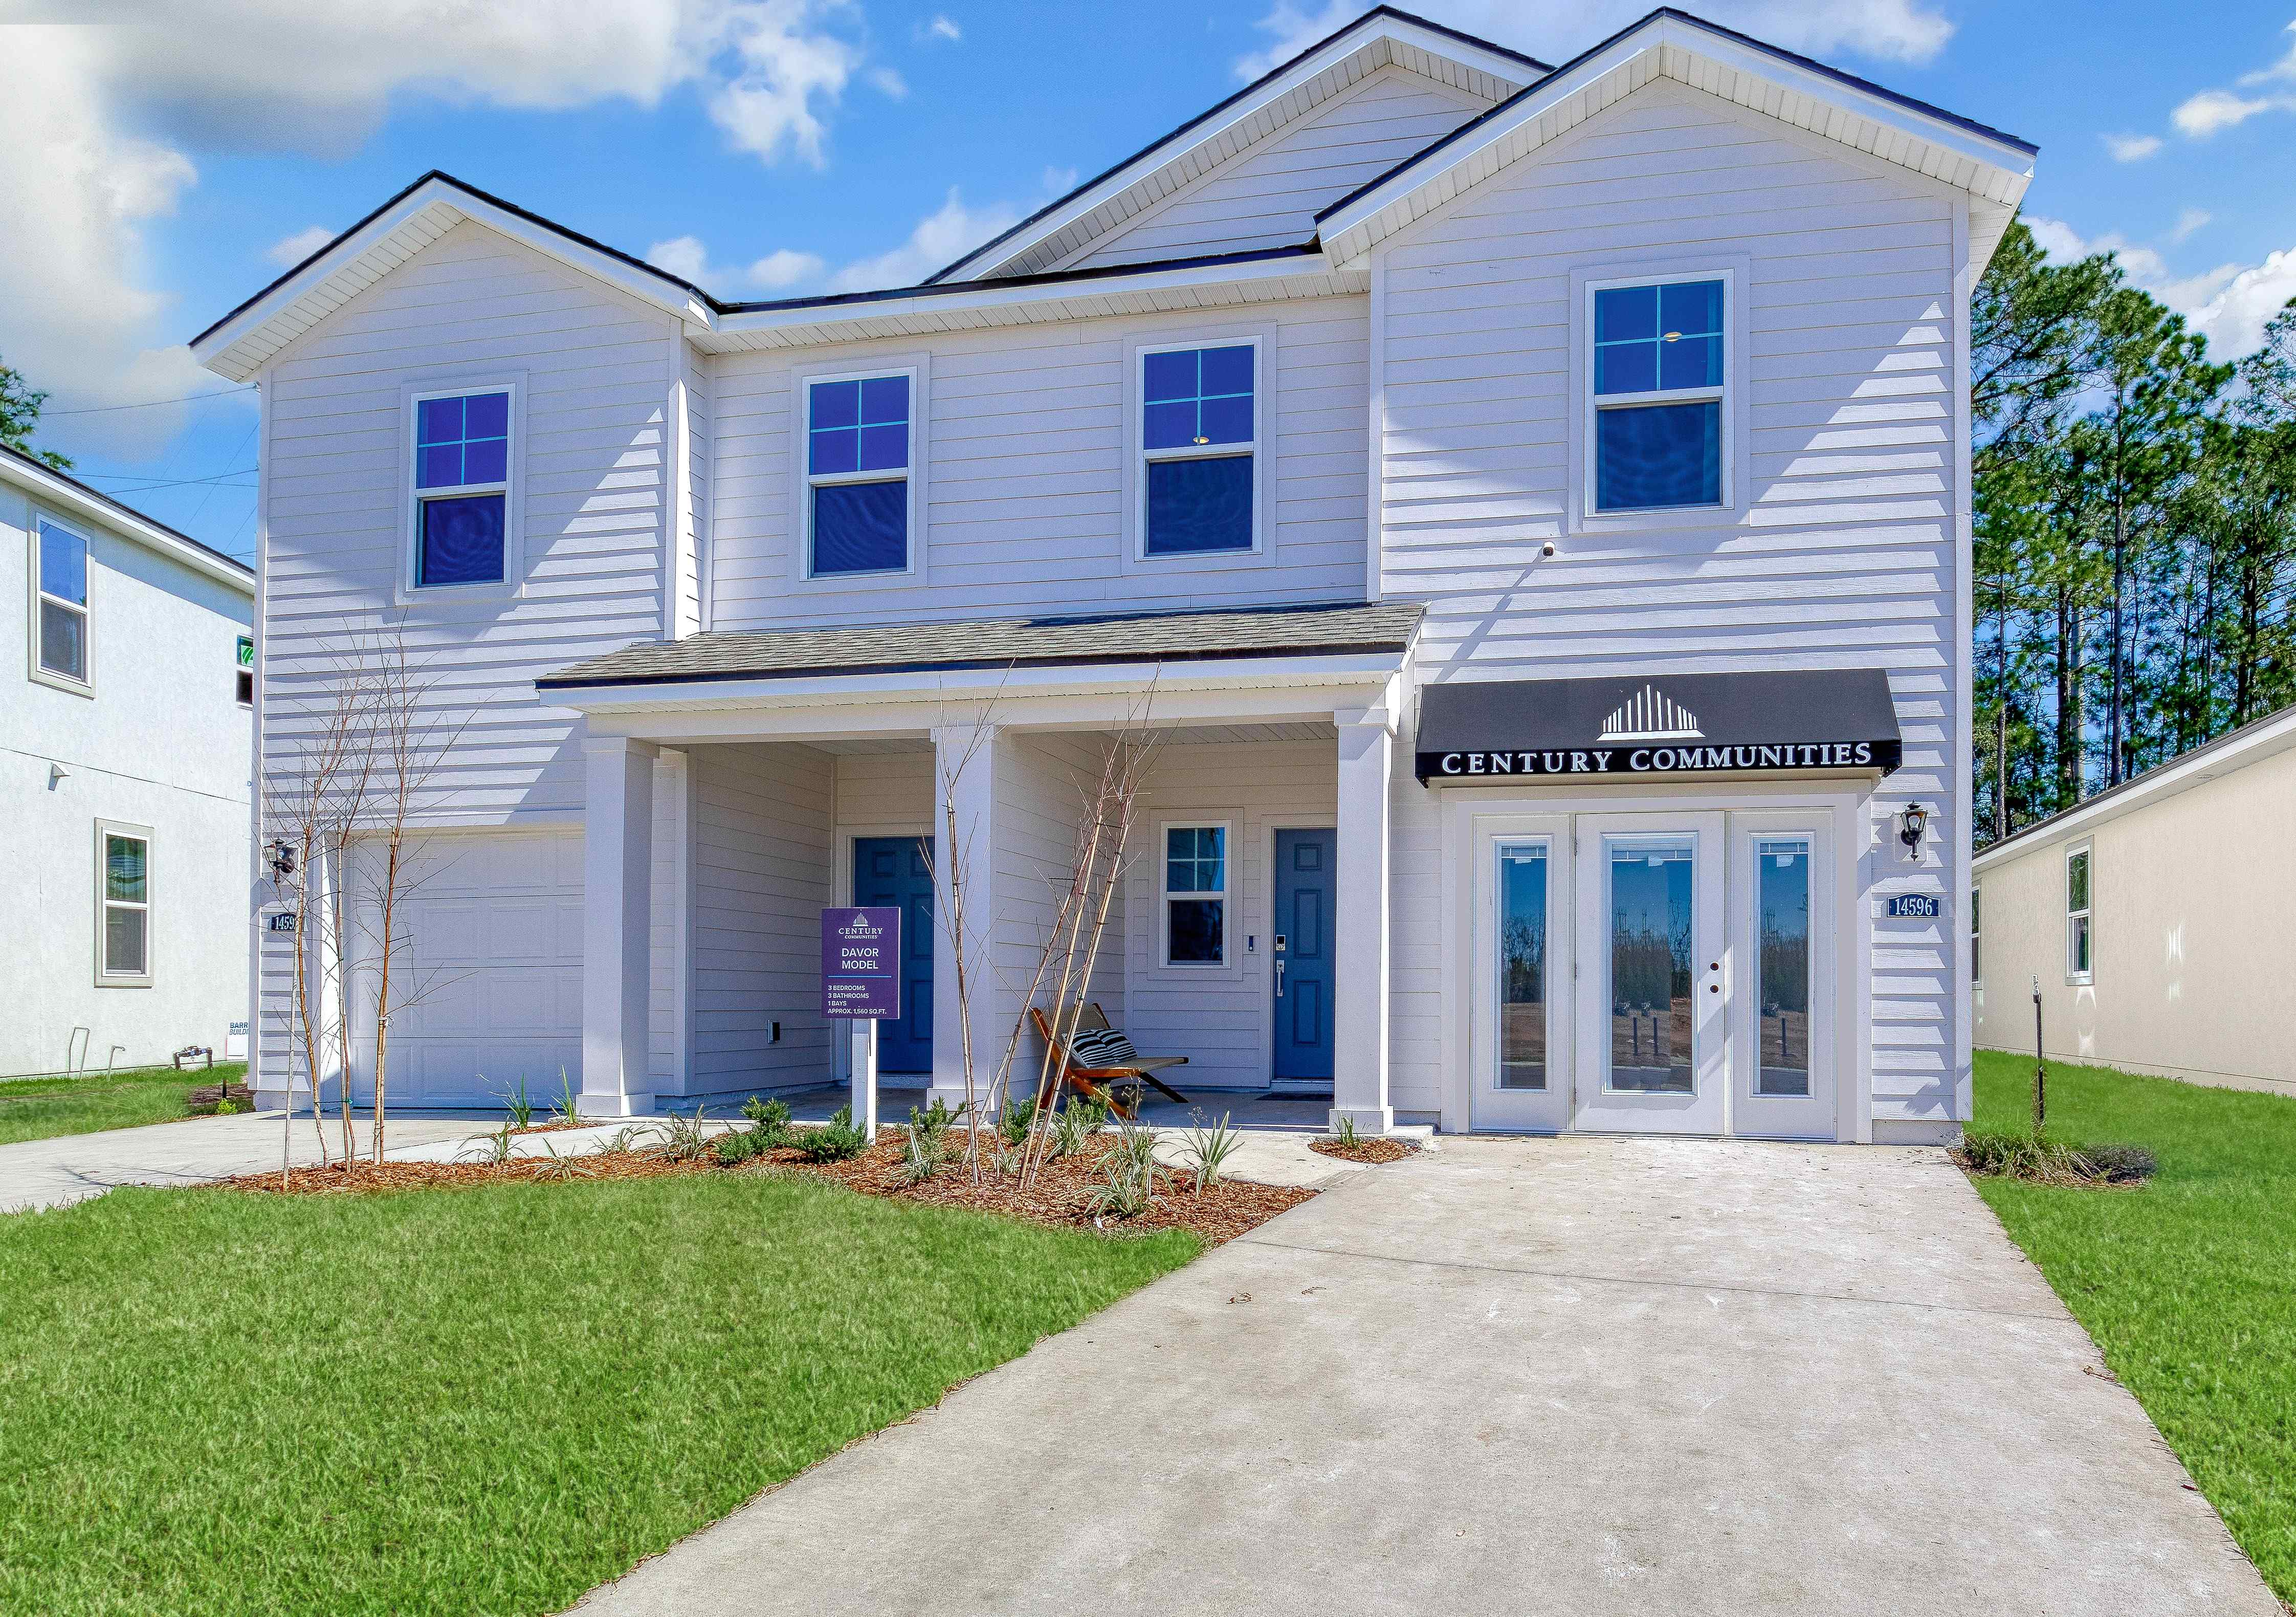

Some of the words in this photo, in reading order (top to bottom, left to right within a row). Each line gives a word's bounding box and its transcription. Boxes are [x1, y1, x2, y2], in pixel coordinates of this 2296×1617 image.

[1442, 751, 1613, 774] CENTURY
[1630, 742, 1870, 771] COMMUNITIES
[1895, 898, 1933, 915] 14596
[275, 916, 295, 930] 1459
[842, 948, 879, 957] DAVOR
[842, 960, 878, 969] MODEL
